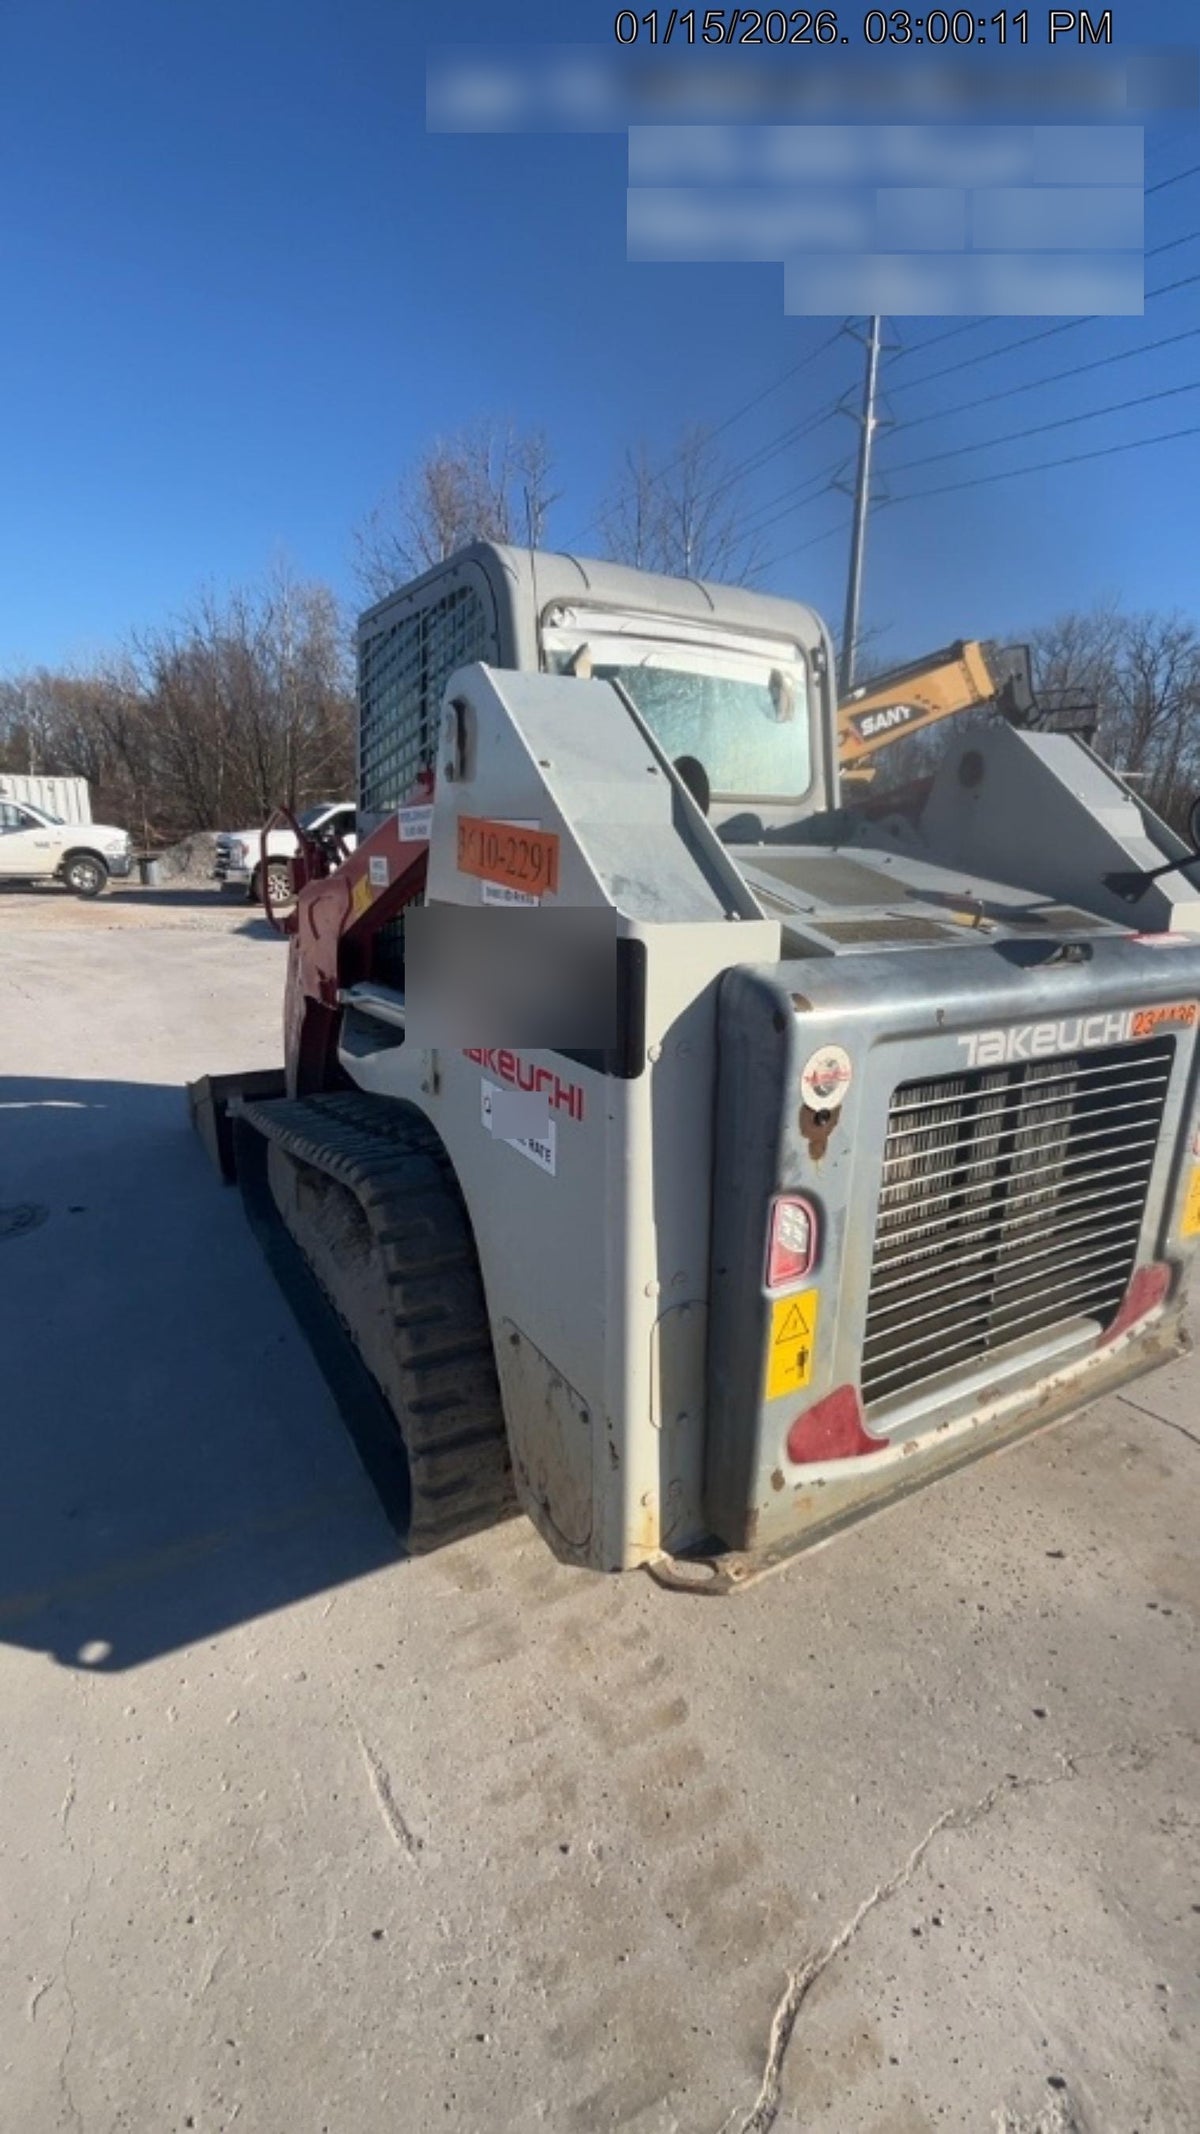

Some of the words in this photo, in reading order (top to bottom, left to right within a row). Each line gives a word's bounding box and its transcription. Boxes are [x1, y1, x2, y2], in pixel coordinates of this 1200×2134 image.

[861, 706, 910, 736] SANY
[958, 1011, 1133, 1067] TAKEUCHI
[462, 1049, 584, 1121] AKEUCHI
